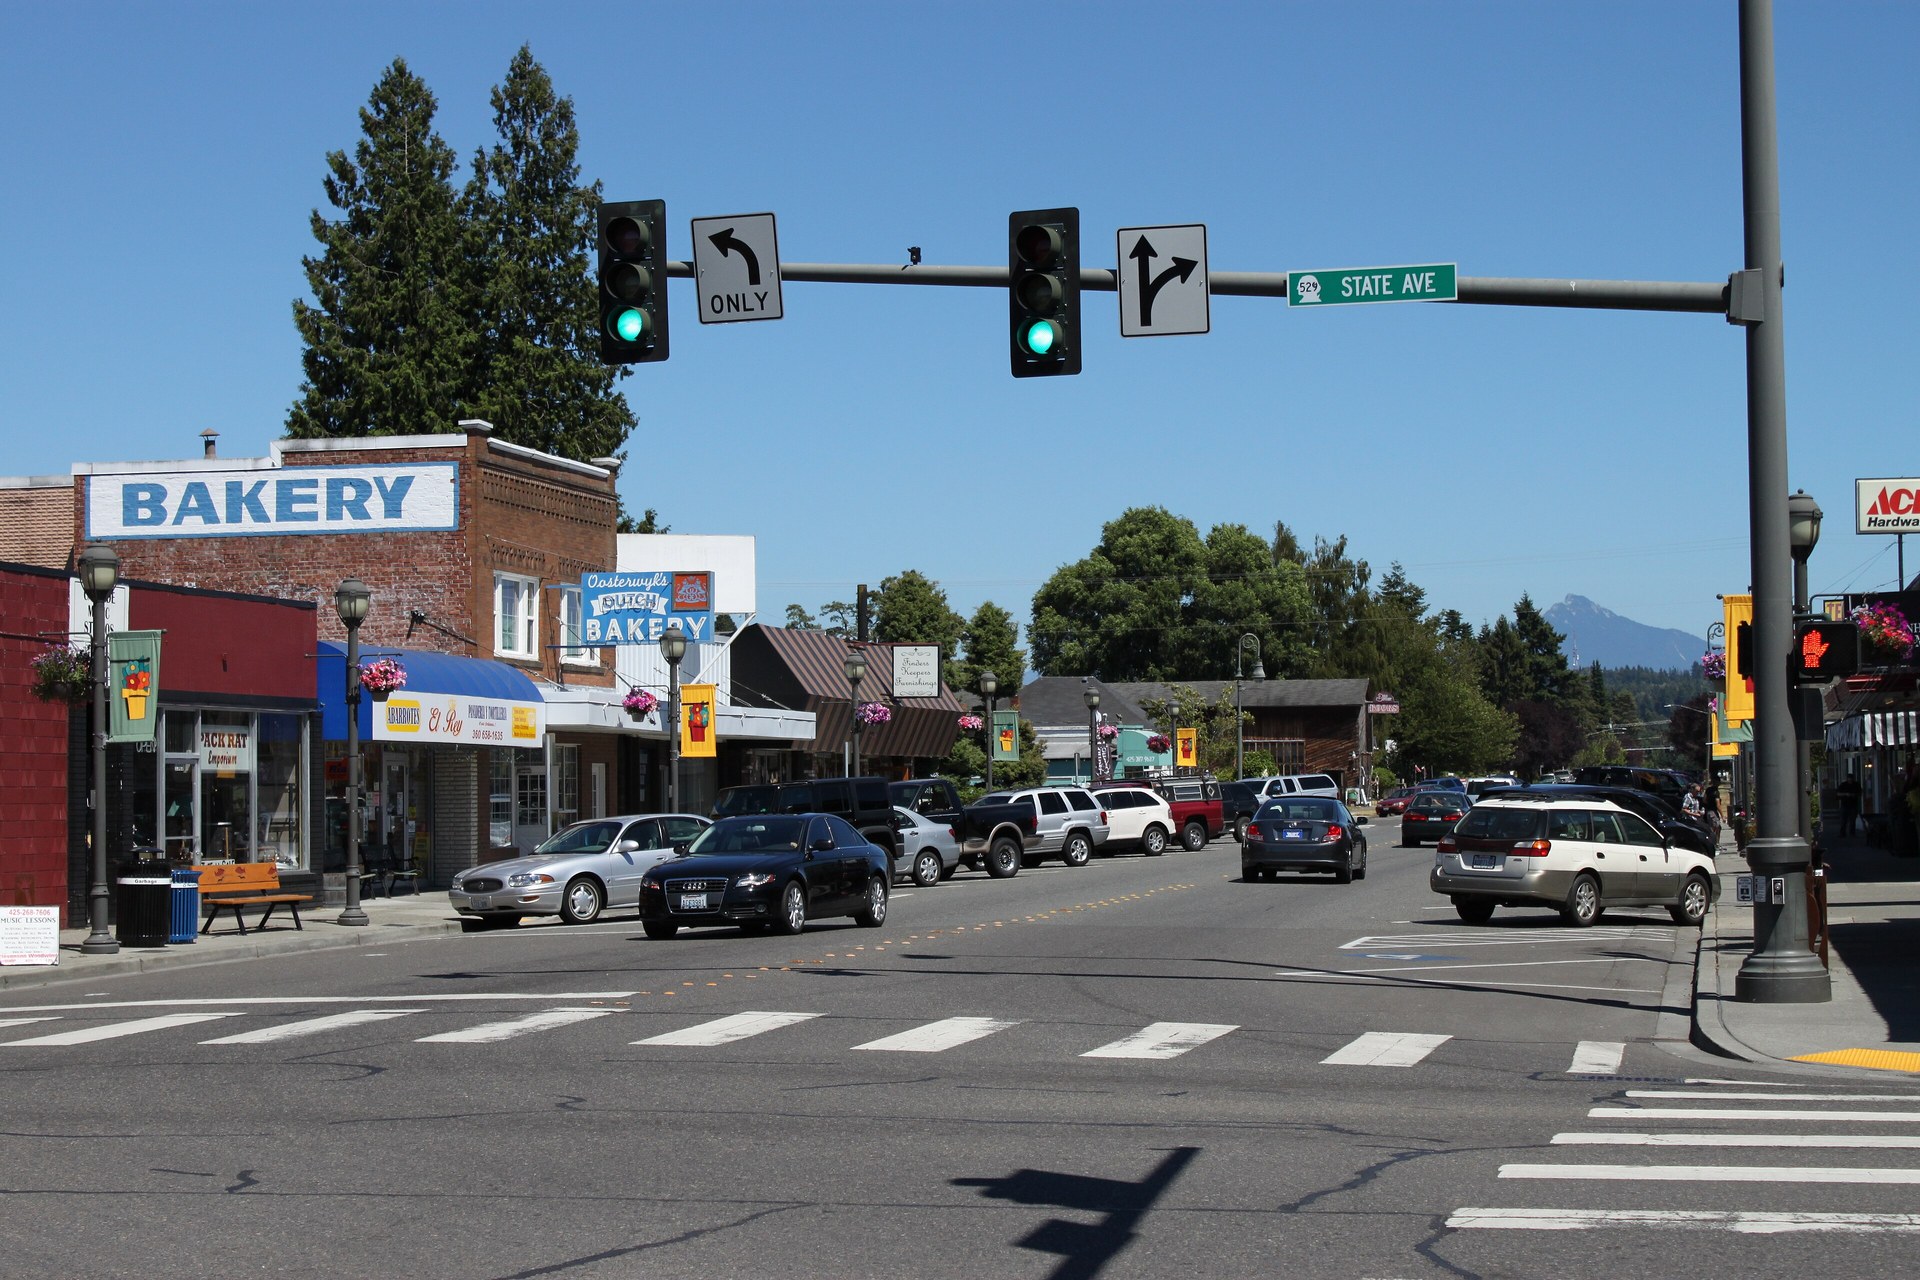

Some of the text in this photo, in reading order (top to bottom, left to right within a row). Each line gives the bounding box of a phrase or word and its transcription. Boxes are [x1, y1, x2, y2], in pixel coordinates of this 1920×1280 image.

[1299, 272, 1436, 297] 529 STATE AVE
[710, 291, 769, 314] ONLY
[122, 475, 416, 527] BAKERY
[587, 573, 670, 592] Oosterwyk's
[602, 592, 657, 609] DUTCH
[902, 657, 930, 667] Finders
[900, 666, 931, 679] Keepers
[894, 676, 938, 689] Furnishings
[428, 707, 463, 737] El Rey
[227, 733, 248, 749] RAT
